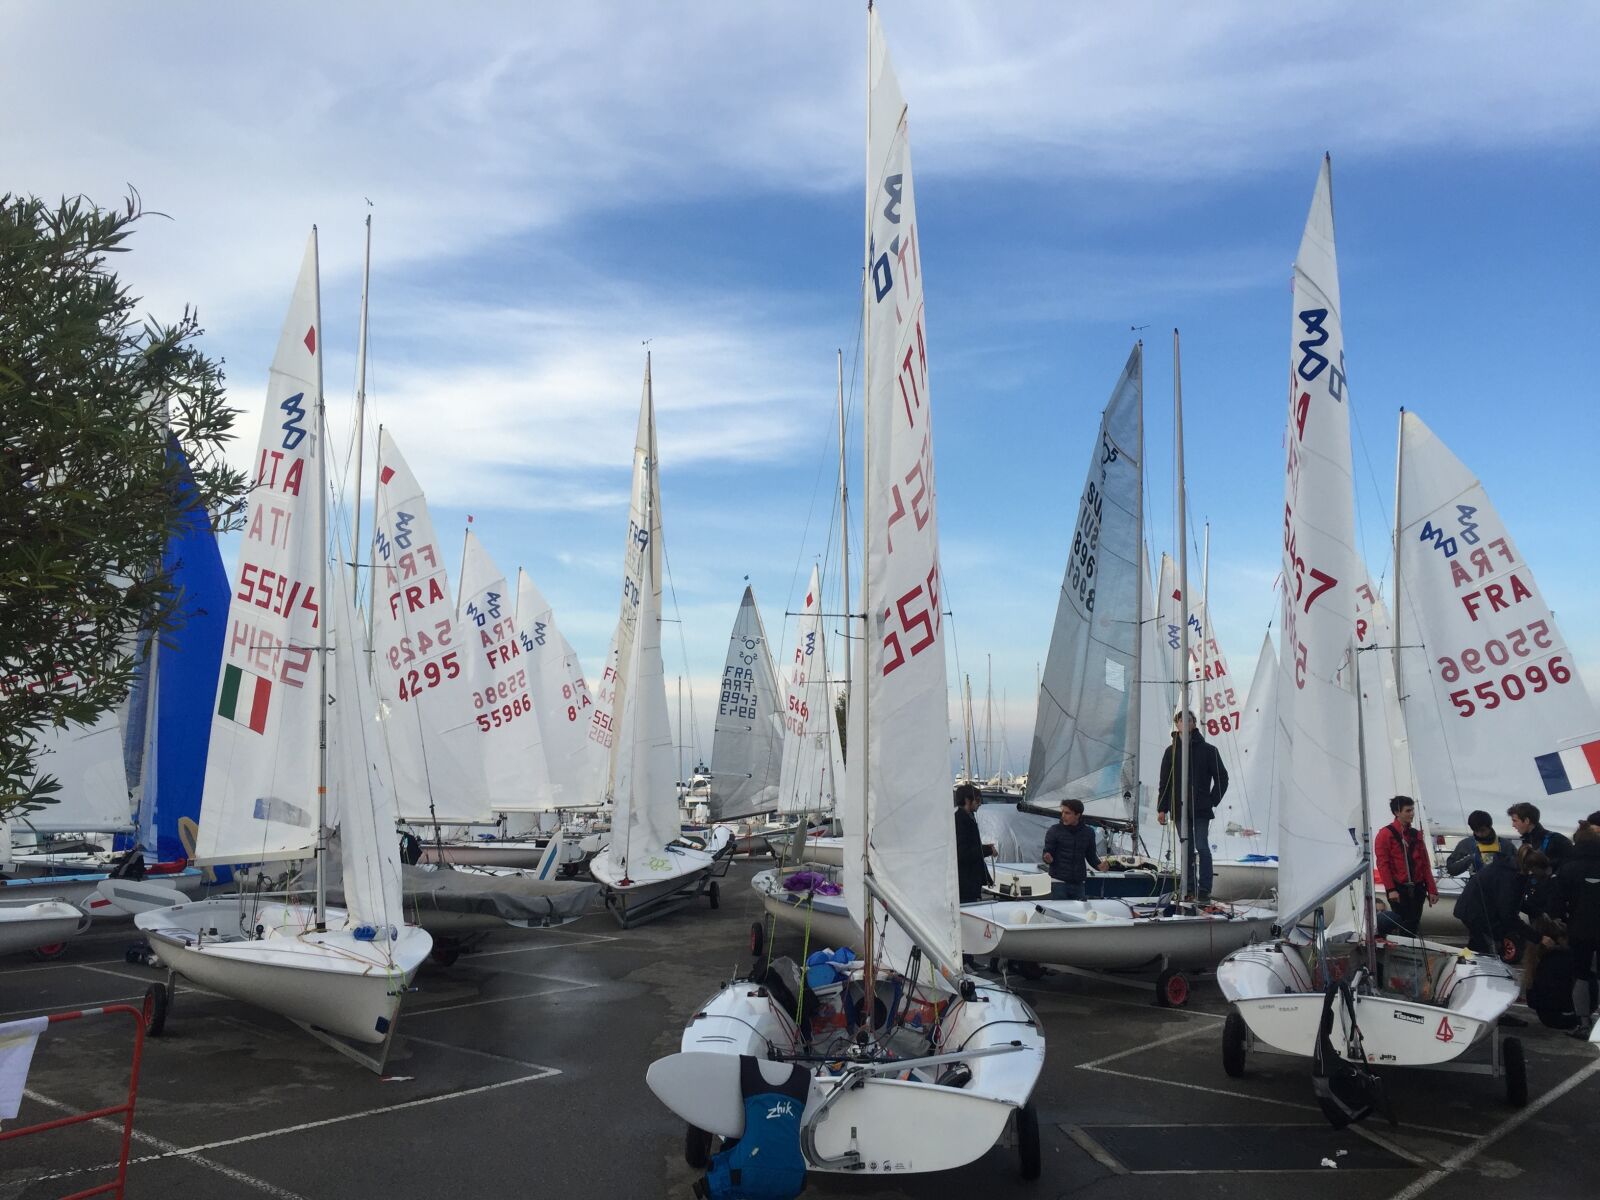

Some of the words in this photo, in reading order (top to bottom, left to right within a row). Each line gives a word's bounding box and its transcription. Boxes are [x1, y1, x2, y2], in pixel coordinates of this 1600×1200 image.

[1298, 308, 1330, 381] 420
[280, 392, 307, 450] 420
[257, 448, 304, 496] ITA
[1420, 520, 1458, 558] 420
[389, 577, 444, 621] FRA
[1461, 574, 1533, 622] FRA
[486, 639, 520, 669] FRA
[725, 665, 753, 680] FRA
[721, 691, 757, 706] 8943
[1449, 656, 1571, 718] 55096
[476, 693, 531, 732] 55986
